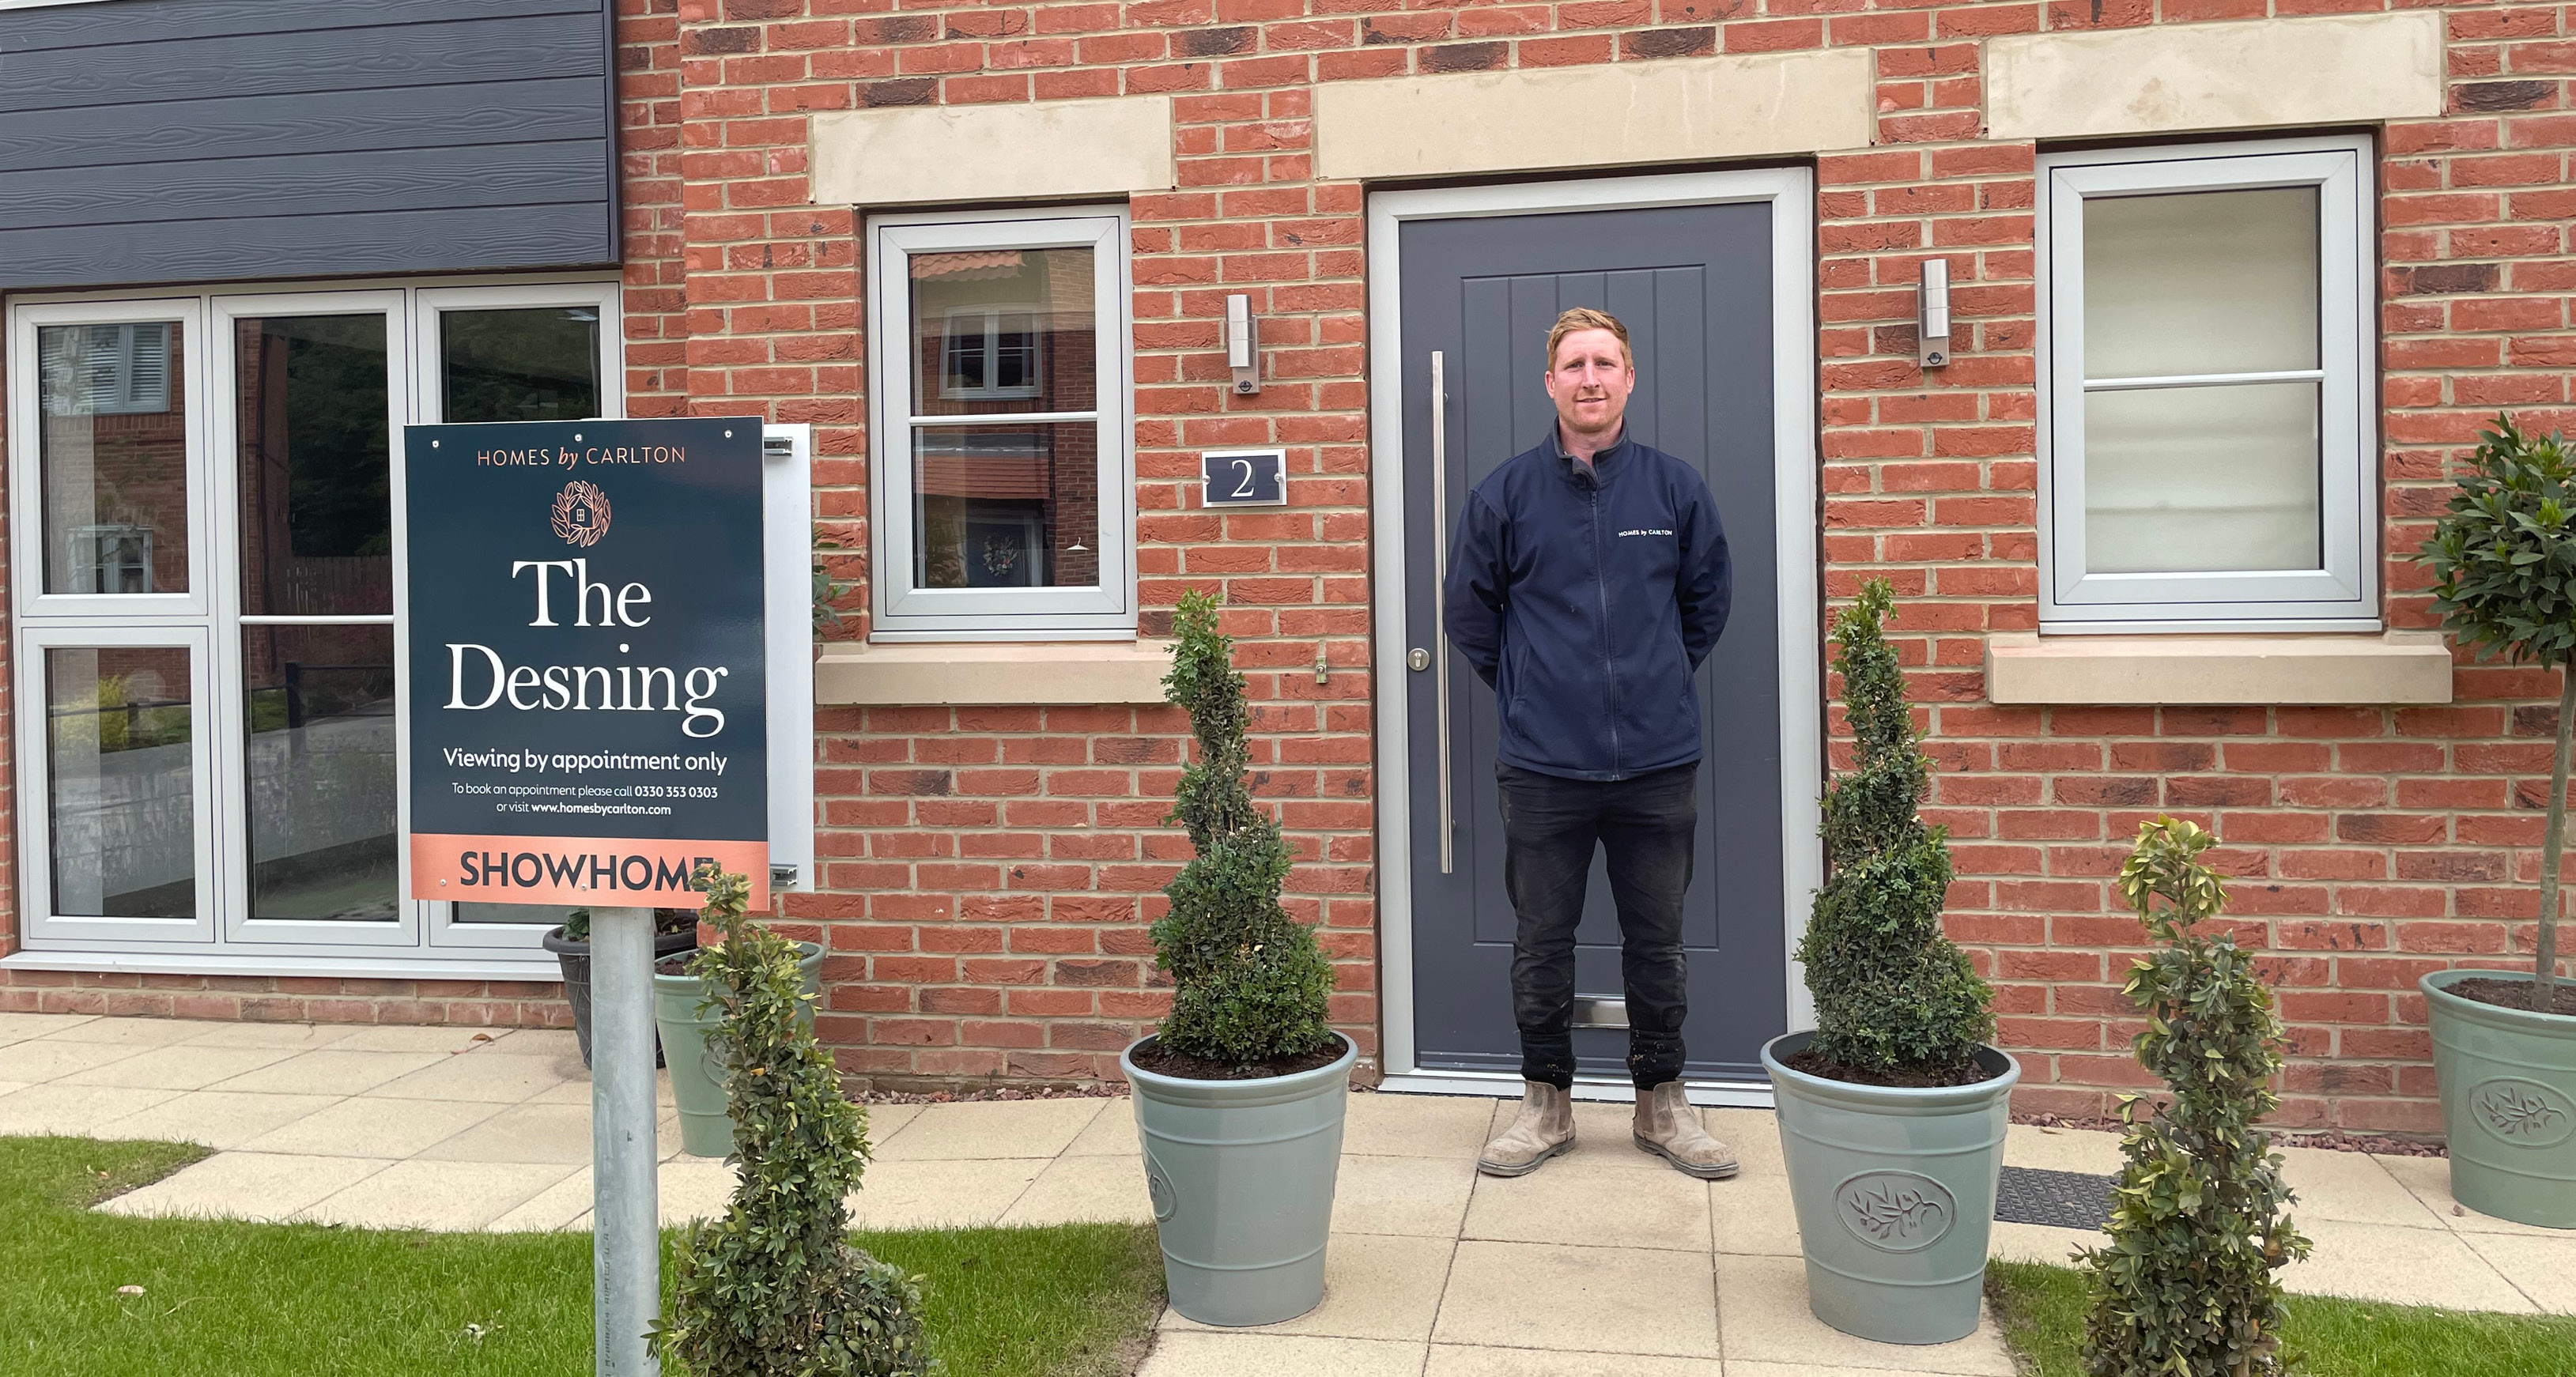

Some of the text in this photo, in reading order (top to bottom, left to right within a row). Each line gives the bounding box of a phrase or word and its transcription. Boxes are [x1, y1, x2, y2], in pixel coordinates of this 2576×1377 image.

[477, 446, 686, 470] HOMES by CARLTON
[1231, 459, 1255, 497] 2
[512, 558, 652, 627] The
[443, 643, 728, 738] Desning
[443, 747, 727, 775] Viewing by appointment only
[451, 782, 718, 798] To book an appointment please call 0330 353 0303
[496, 801, 671, 817] or visit www.homesbycarlton.com
